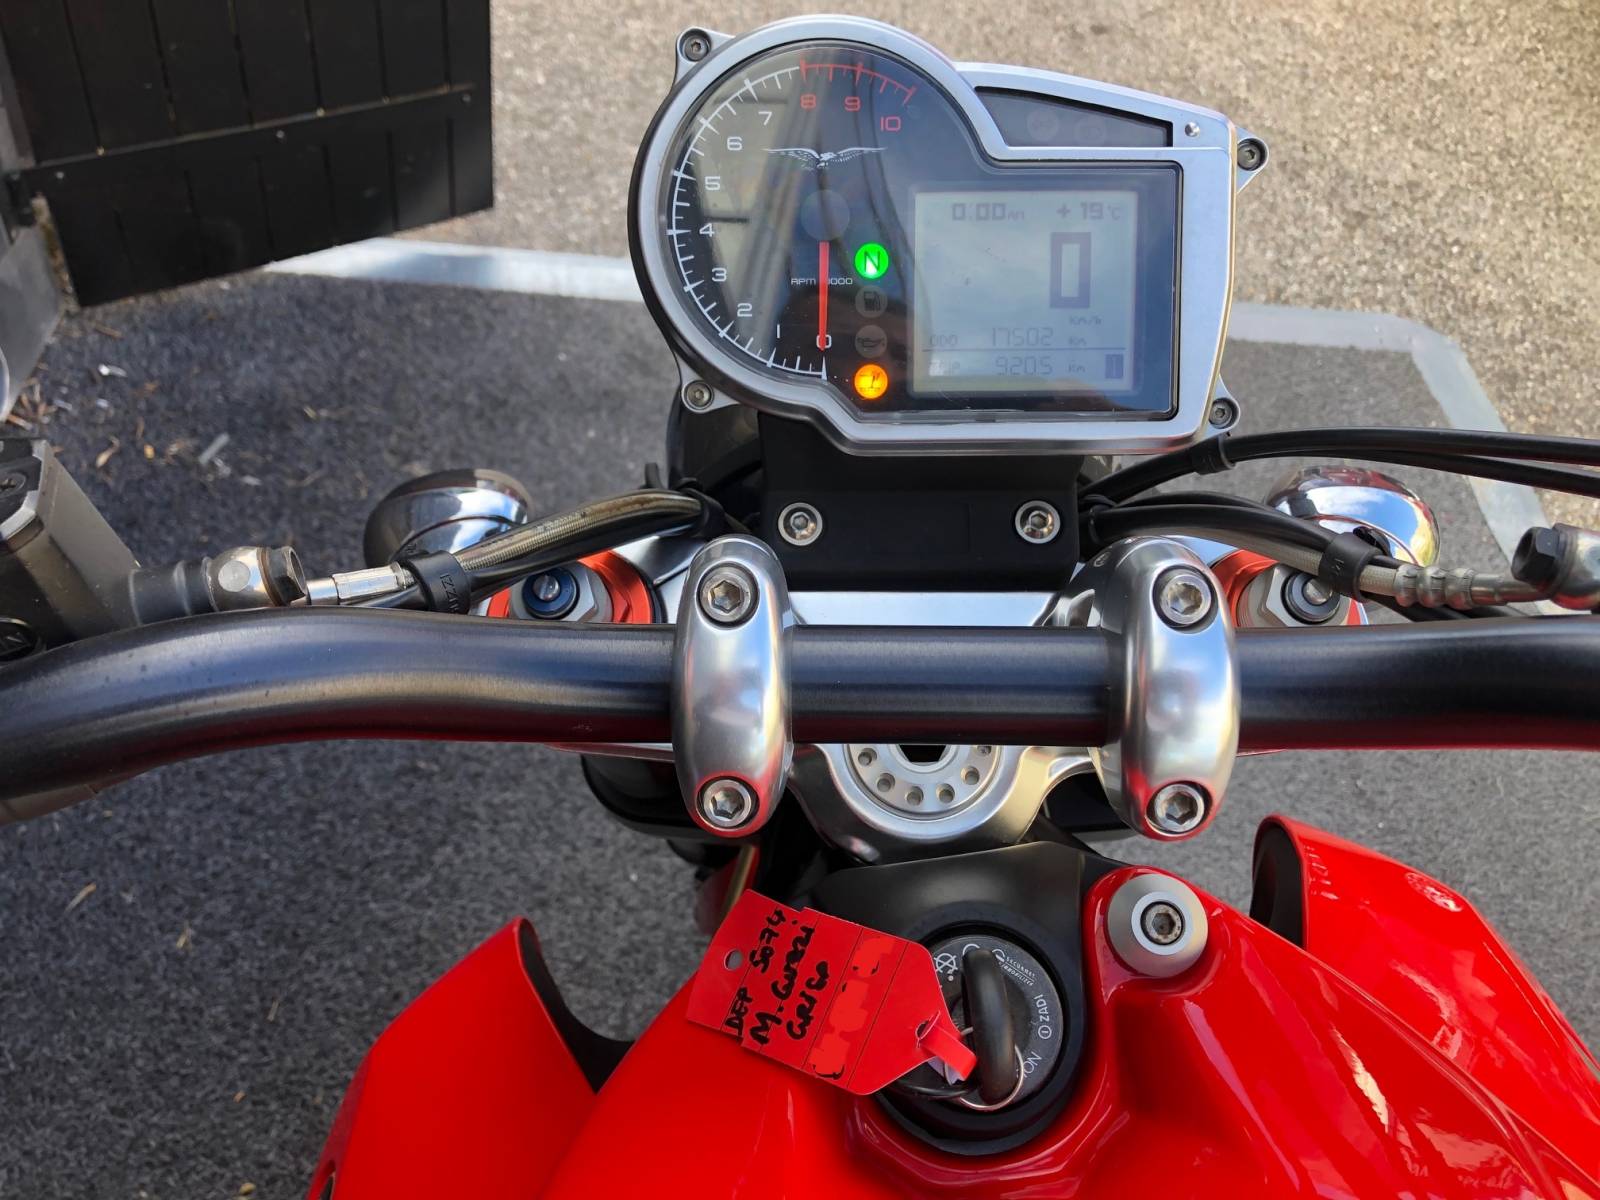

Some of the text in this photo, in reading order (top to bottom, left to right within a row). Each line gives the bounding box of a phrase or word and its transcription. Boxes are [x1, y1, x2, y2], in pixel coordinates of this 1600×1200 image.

[801, 94, 816, 109] 8
[845, 97, 861, 112] 9
[758, 111, 773, 126] 7
[880, 116, 901, 132] 10
[727, 136, 743, 151] 6
[705, 176, 720, 191] 5
[699, 223, 715, 238] 4
[863, 252, 881, 272] N
[711, 267, 727, 282] 3
[791, 277, 816, 286] RPM
[737, 303, 752, 317] 2
[992, 327, 1054, 347] 17502
[1034, 995, 1050, 1022] ZADI
